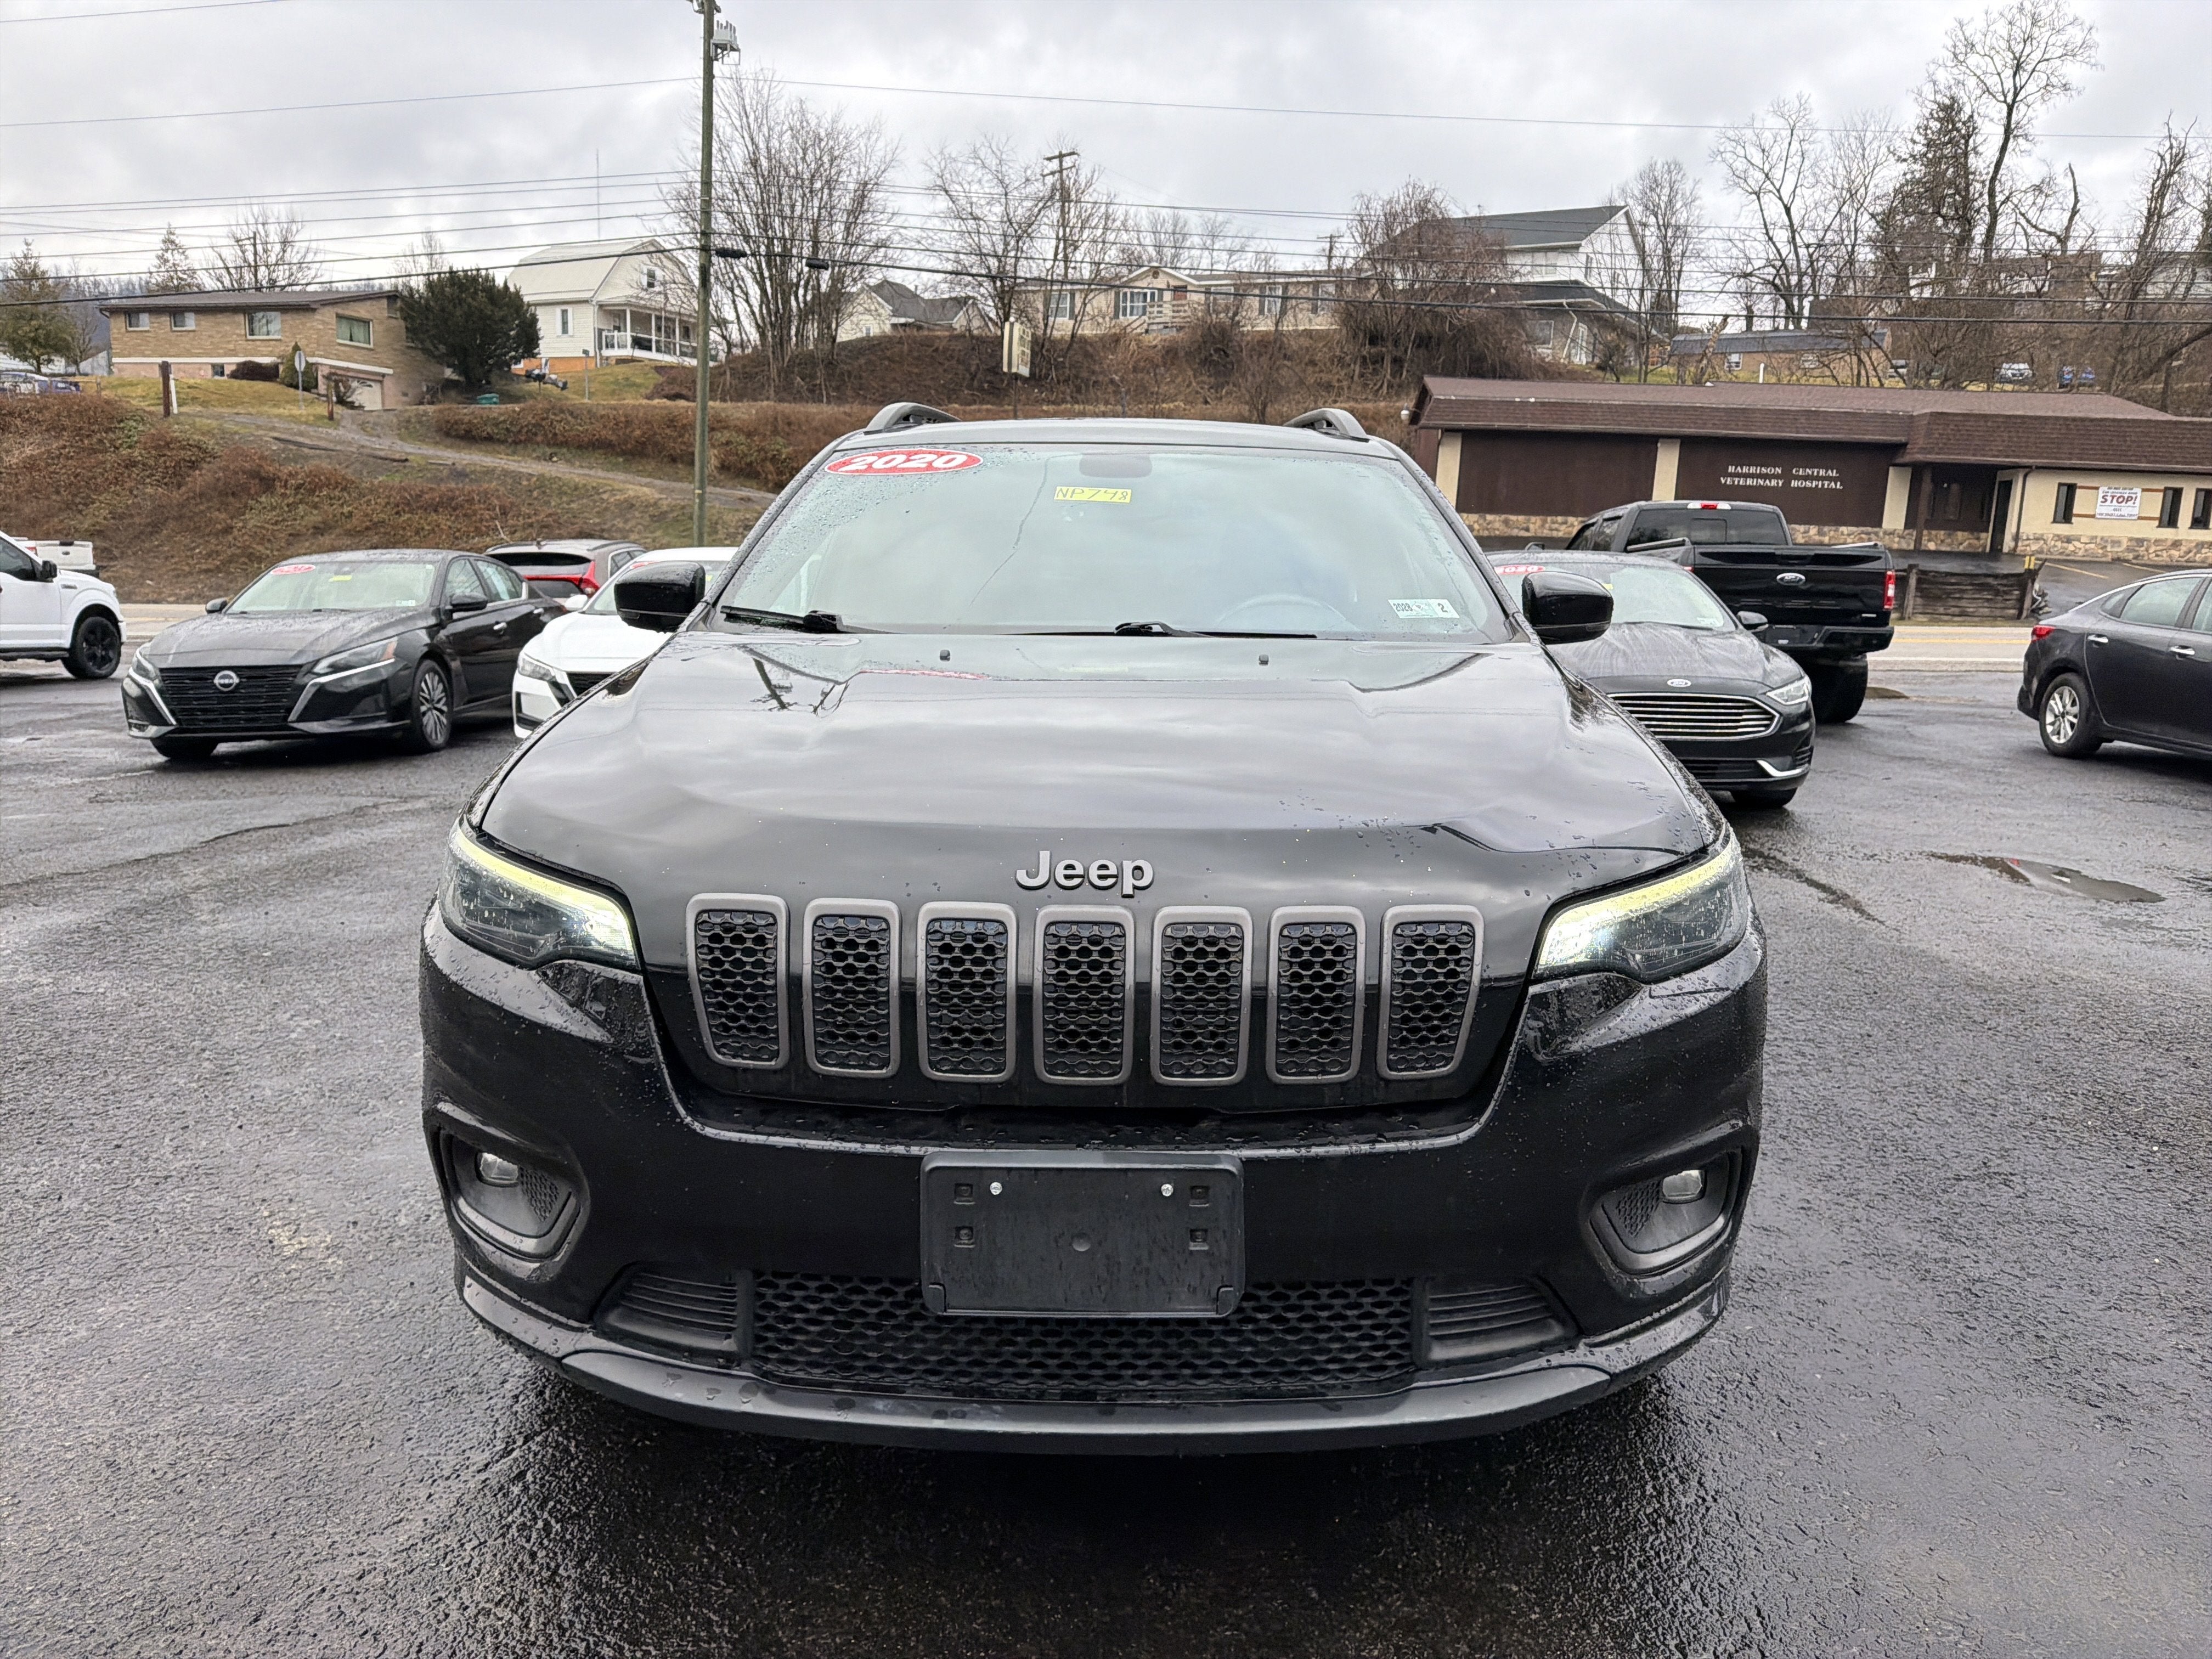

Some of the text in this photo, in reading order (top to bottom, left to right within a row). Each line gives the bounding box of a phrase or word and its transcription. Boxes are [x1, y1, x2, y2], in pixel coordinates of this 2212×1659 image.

[838, 454, 967, 472] 2020
[1728, 465, 1839, 477] HARRISON CENTRAL
[1720, 477, 1843, 489] VETERINARY HOSPITAL
[2100, 494, 2138, 505] STOP!
[1393, 602, 1448, 613] 2028 2
[1015, 850, 1155, 898] Jeep
